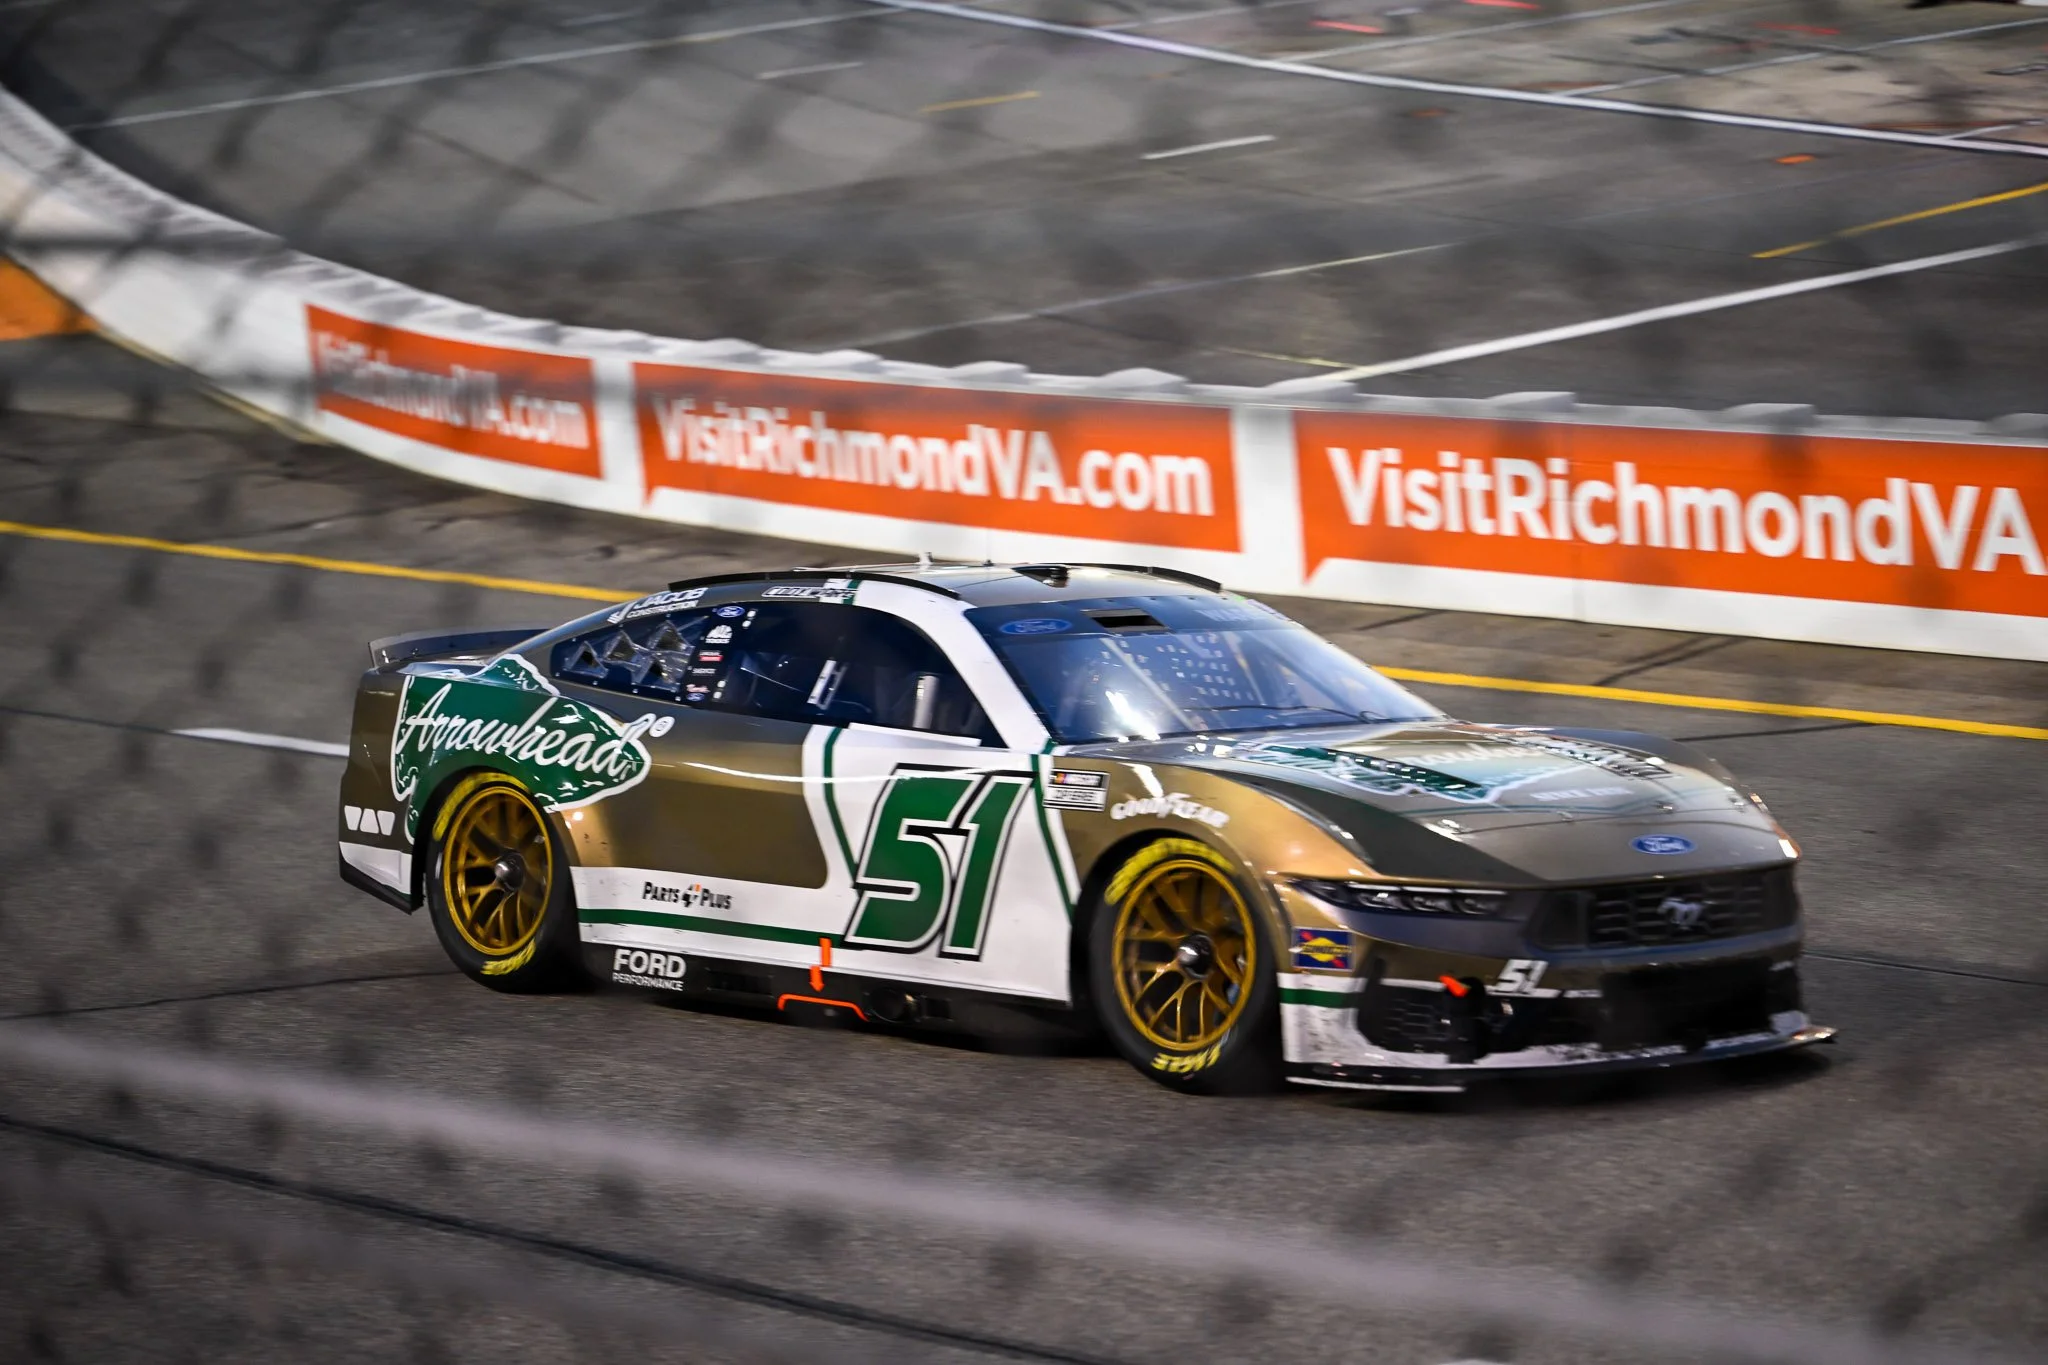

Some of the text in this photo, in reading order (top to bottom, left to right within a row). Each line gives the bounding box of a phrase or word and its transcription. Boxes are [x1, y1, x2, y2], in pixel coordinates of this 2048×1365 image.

[655, 398, 1214, 516] VisitRichmondVA.com
[626, 600, 699, 618] CONSTRUCTION
[633, 587, 708, 609] JACOB
[397, 683, 654, 778] Arrowhead
[841, 762, 1039, 961] 51
[613, 948, 687, 978] FORD
[1496, 959, 1549, 994] 51
[613, 972, 684, 991] PERFORMANCE
